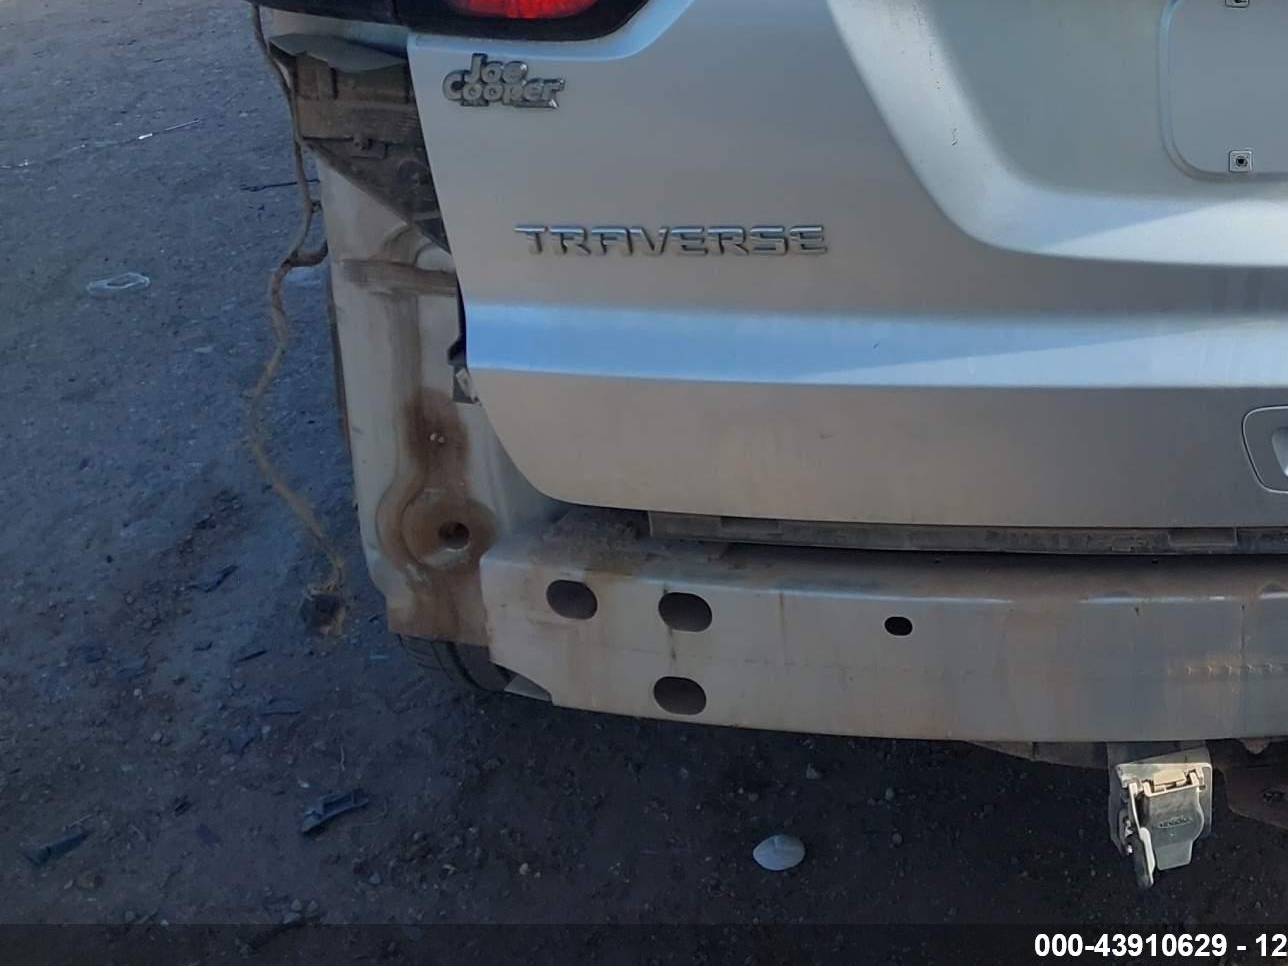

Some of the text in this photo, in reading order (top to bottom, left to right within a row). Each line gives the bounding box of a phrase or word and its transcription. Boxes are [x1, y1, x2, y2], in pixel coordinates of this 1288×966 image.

[463, 52, 528, 83] Joe
[442, 70, 566, 107] Cooper
[513, 224, 828, 256] TRAVERSE
